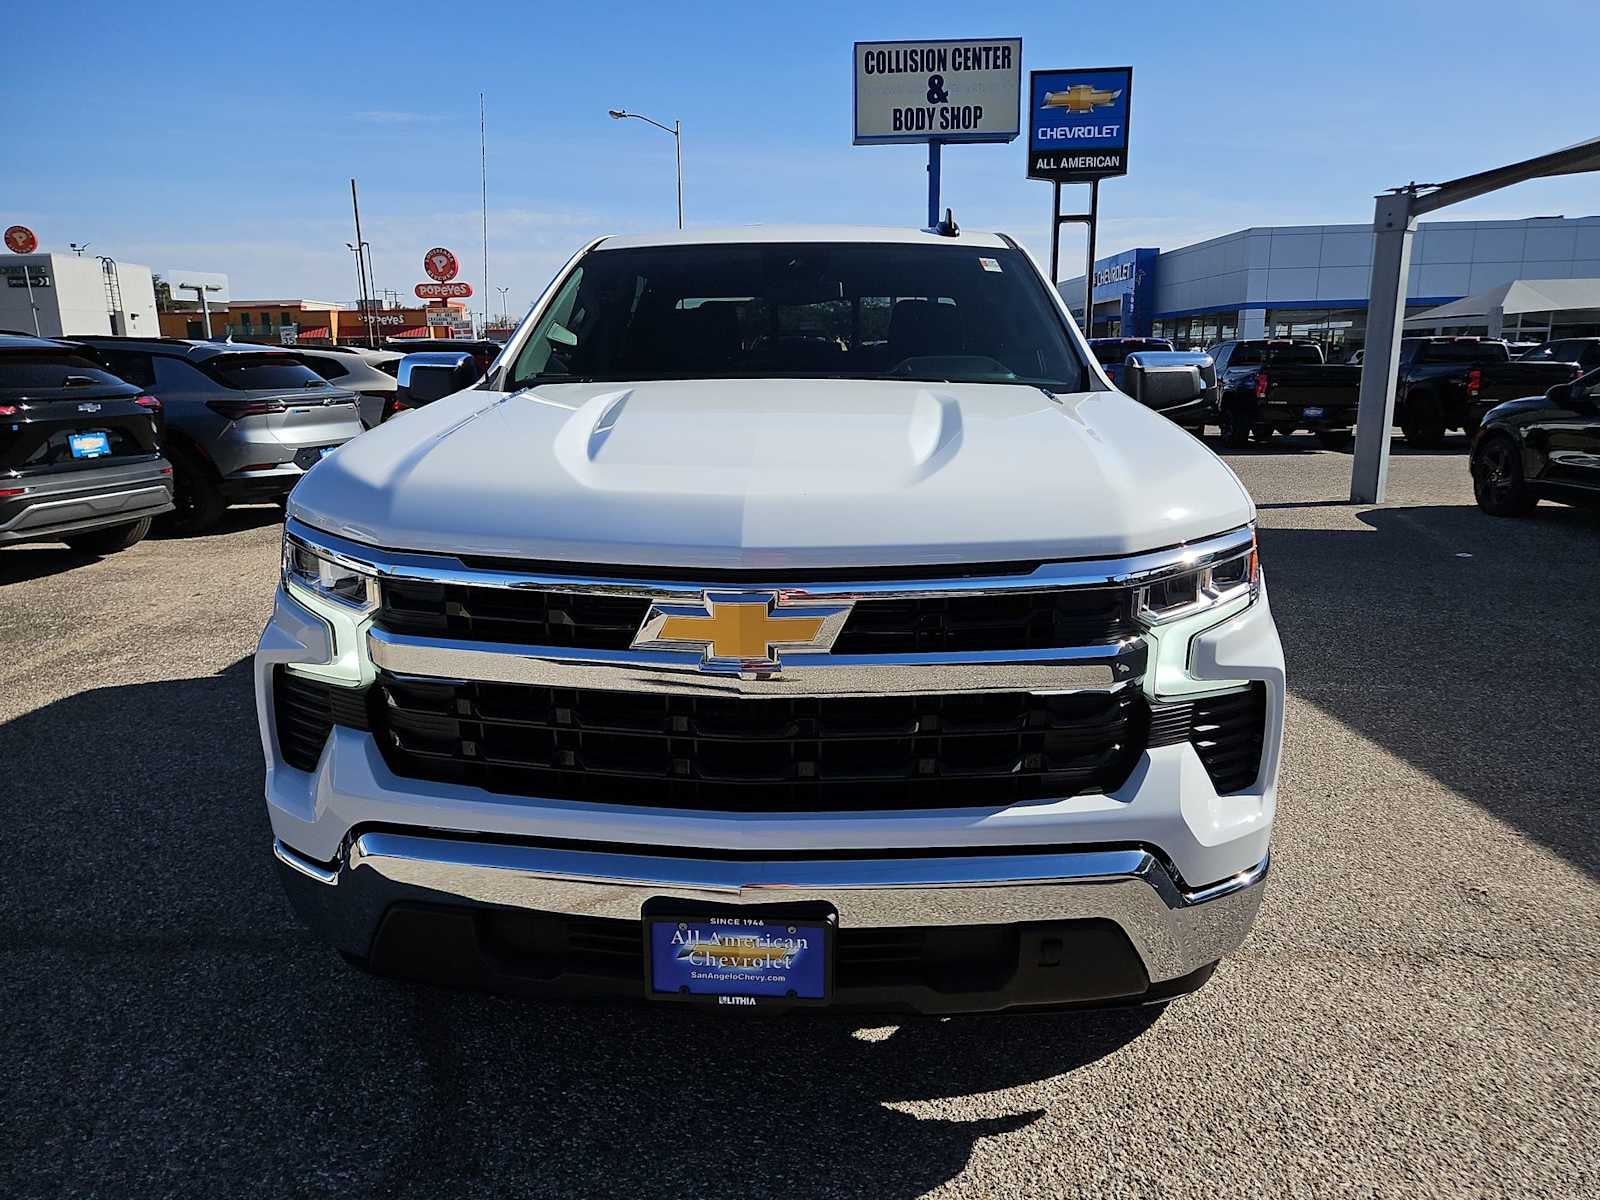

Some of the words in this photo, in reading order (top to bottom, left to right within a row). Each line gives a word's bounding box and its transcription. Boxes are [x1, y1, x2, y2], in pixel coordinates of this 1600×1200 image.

[864, 48, 947, 74] COLLISION
[951, 45, 1011, 71] CENTER
[927, 74, 948, 104] &
[893, 107, 935, 131] BODY
[939, 105, 983, 129] SHOP
[1038, 125, 1120, 139] CHEVROLET
[1036, 157, 1057, 169] ALL
[1060, 156, 1120, 168] AMERICAN
[710, 917, 740, 925] SINCE
[671, 930, 699, 945] All
[711, 931, 808, 950] American
[689, 950, 792, 969] Chevrolet
[691, 971, 786, 982] SanAngeloChevy.com
